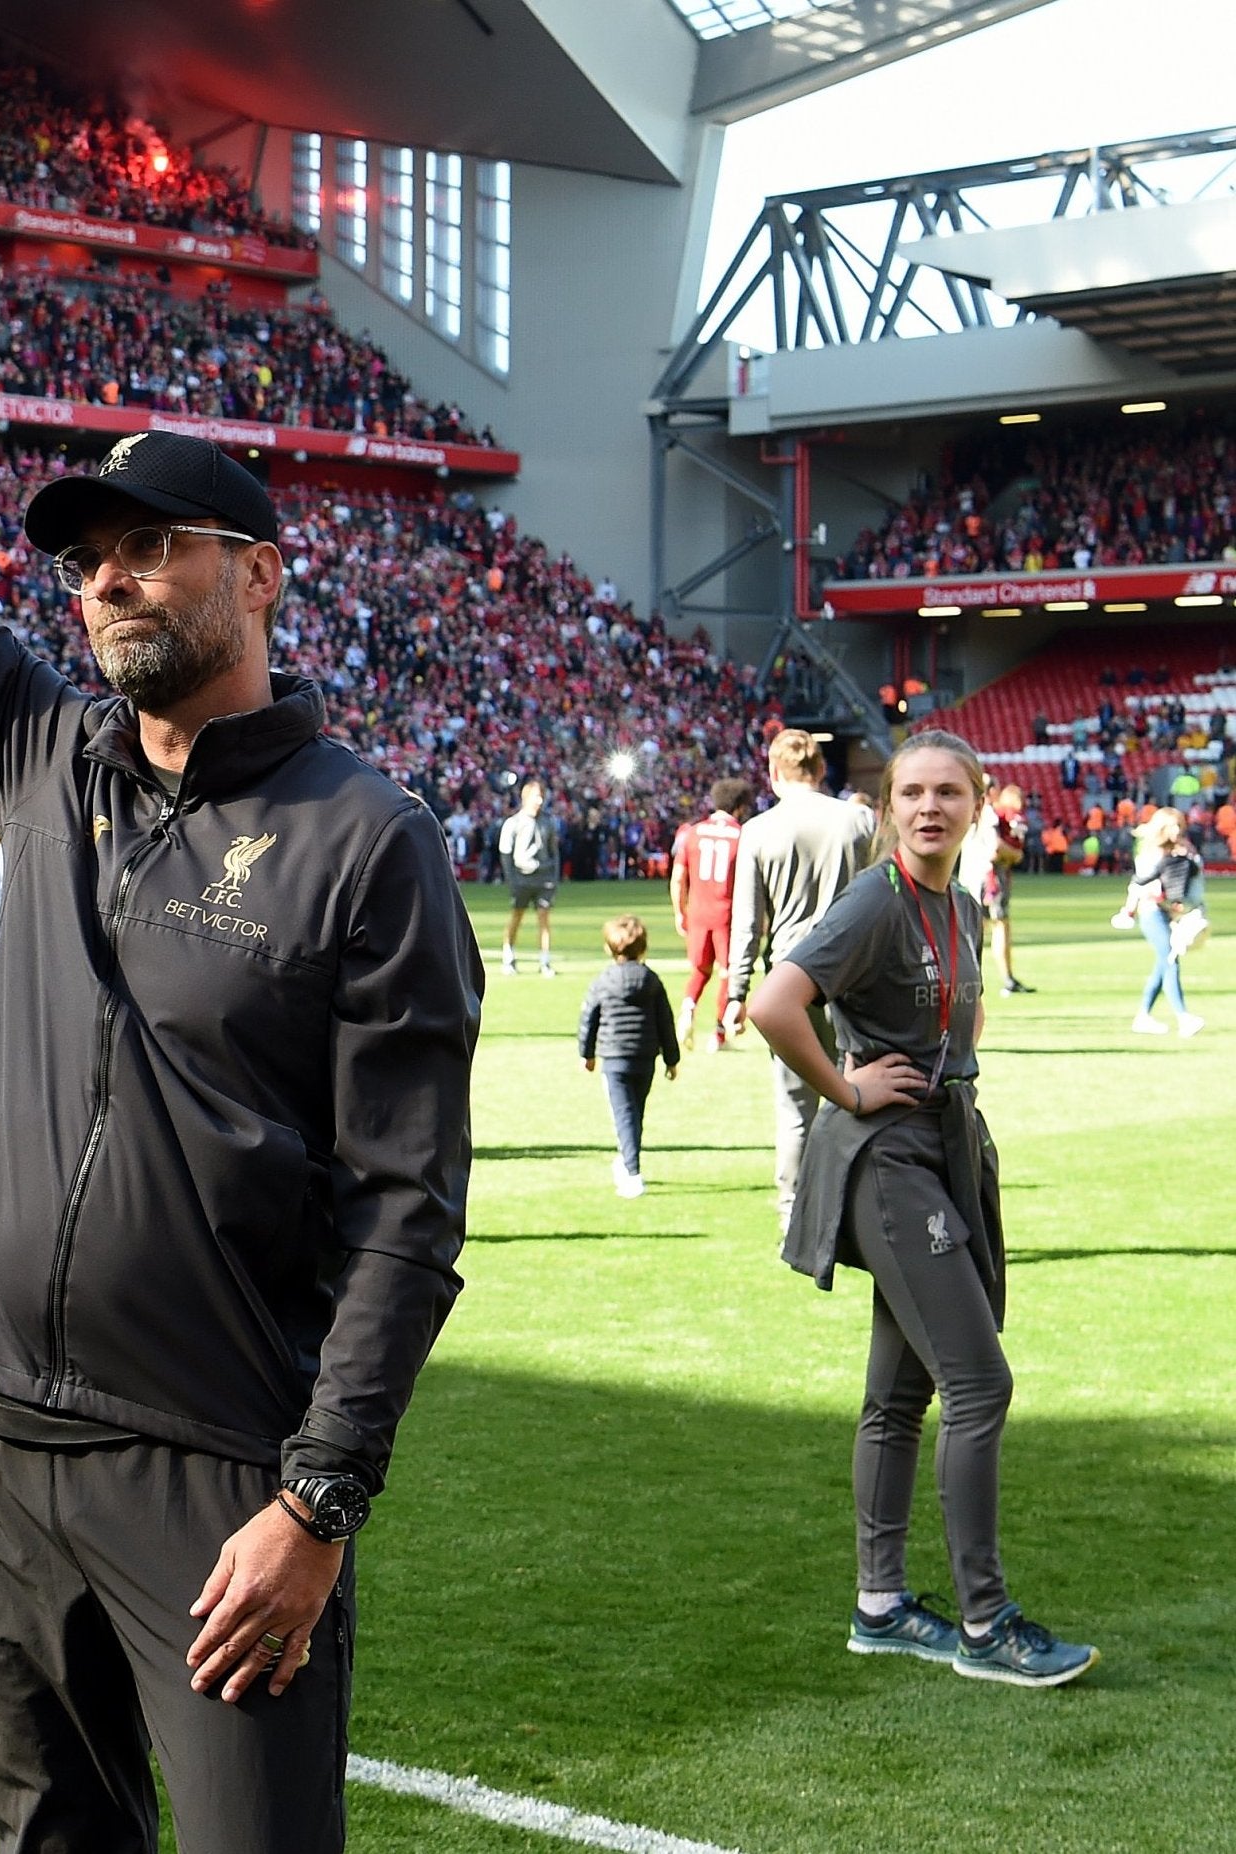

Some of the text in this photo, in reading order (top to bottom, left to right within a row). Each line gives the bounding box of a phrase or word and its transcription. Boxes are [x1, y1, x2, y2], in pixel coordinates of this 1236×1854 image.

[924, 581, 1081, 606] Standard Chartered
[697, 838, 730, 883] 11
[164, 898, 269, 941] BETVICTOR
